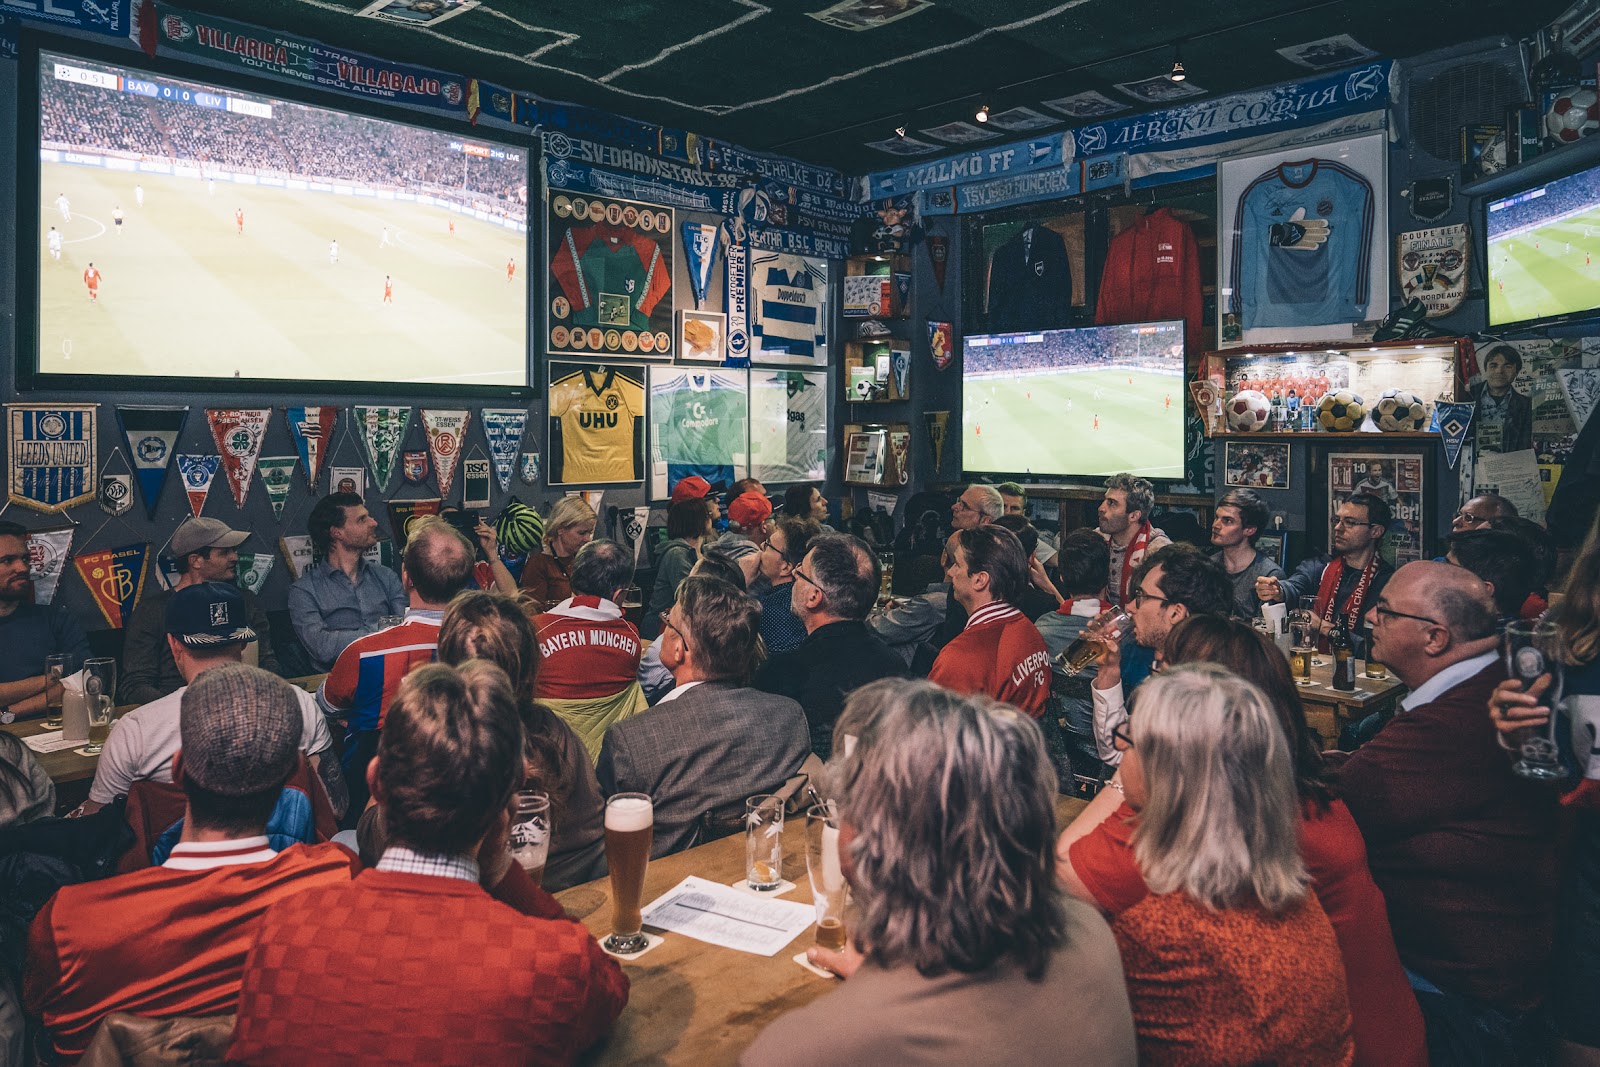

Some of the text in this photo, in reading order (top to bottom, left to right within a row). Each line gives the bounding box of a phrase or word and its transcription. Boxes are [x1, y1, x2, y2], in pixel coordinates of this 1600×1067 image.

[195, 24, 288, 67] VILLARIBA
[275, 38, 358, 65] FAIRY ULTRAS
[240, 57, 279, 72] YOU'LL
[281, 67, 315, 81] NEVER
[351, 84, 396, 98] ALONE
[337, 61, 441, 96] VILLABAJO
[127, 80, 222, 107] BAY 0 0 LIV
[1229, 85, 1338, 124] СОФИЯ
[450, 141, 462, 151] sky
[464, 145, 488, 155] SPORT
[506, 153, 520, 162] LIVE
[609, 148, 712, 187] DARMSTADT
[717, 173, 738, 188] 98
[755, 161, 810, 184] SCHALKE
[816, 174, 832, 189] 04
[906, 149, 1015, 188] MALMÖ FF
[963, 189, 985, 204] TSV
[798, 215, 815, 228] FSV
[748, 228, 782, 248] HERTHA
[1402, 230, 1435, 241] COUPE
[1410, 237, 1453, 251] FINALE
[729, 244, 737, 299] #TOGETHER
[736, 258, 745, 313] PREMIER
[1421, 292, 1462, 301] BORDEAUX
[579, 411, 618, 429] UHU
[681, 416, 719, 429] Commodore
[20, 442, 87, 466] LEEDS UNITED
[466, 463, 488, 473] RSC
[1333, 466, 1352, 485] Bild
[1353, 462, 1366, 474] 1:0
[84, 549, 141, 564] FC BASEL
[1347, 606, 1360, 630] UEFA
[538, 629, 638, 659] BAYERN MÜNCHEN
[1034, 669, 1045, 689] FC
